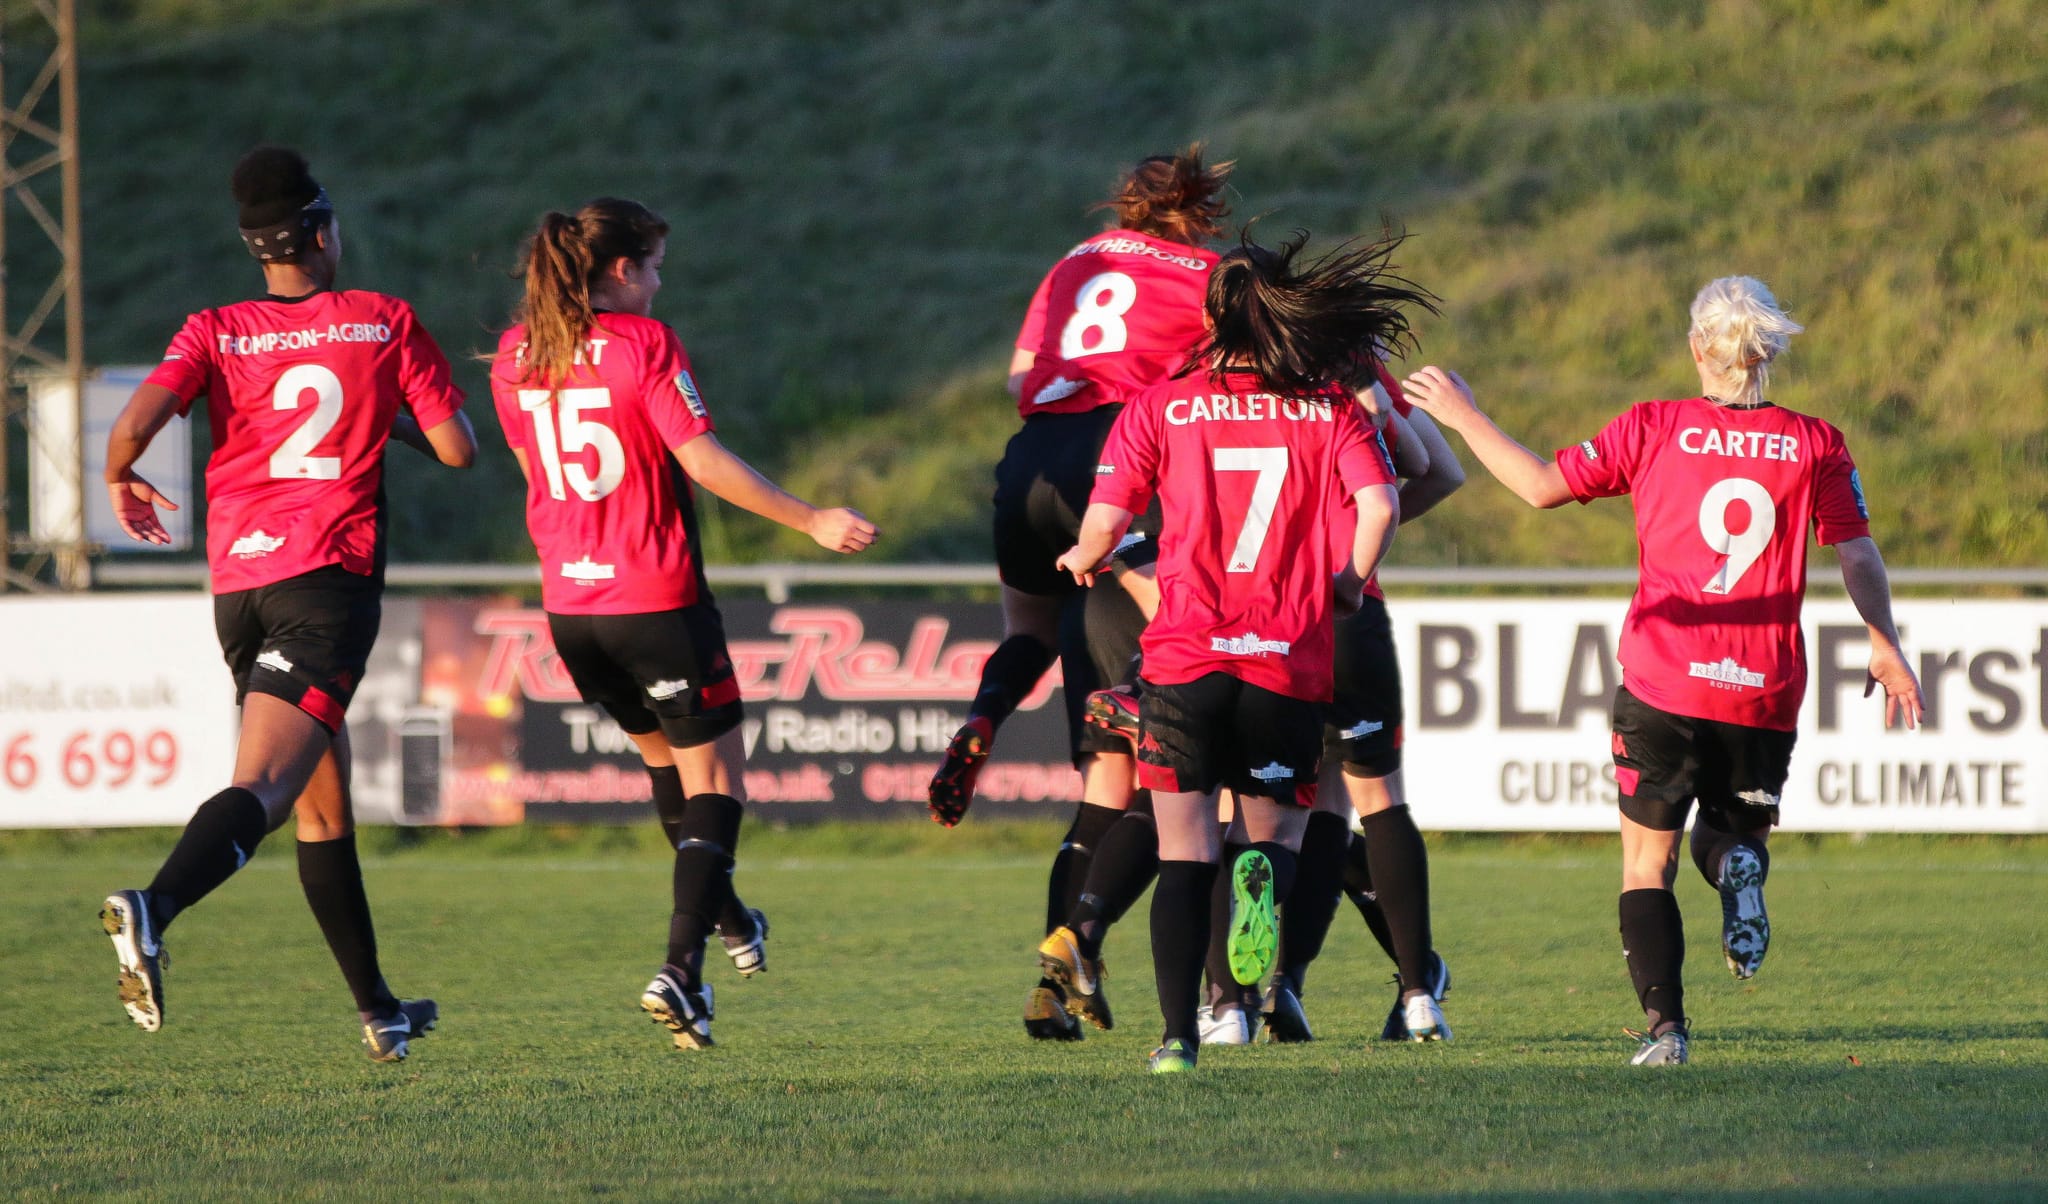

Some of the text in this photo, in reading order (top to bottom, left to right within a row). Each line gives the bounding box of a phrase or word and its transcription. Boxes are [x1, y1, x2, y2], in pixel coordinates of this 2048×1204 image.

[217, 323, 391, 355] THOMPSON-AGBRO
[1061, 272, 1137, 360] 8
[269, 364, 344, 480] 2
[1165, 393, 1333, 426] CARLETON
[517, 387, 626, 502] 15
[1679, 427, 1799, 462] CARTER
[1213, 447, 1289, 573] 7
[1699, 477, 1776, 595] 9
[1418, 624, 1615, 729] BLA
[1694, 666, 1762, 684] REGENCY
[1709, 681, 1743, 692] ROUTE
[766, 706, 896, 753] Radio
[62, 730, 178, 789] 699
[1817, 760, 2025, 806] CLIMATE
